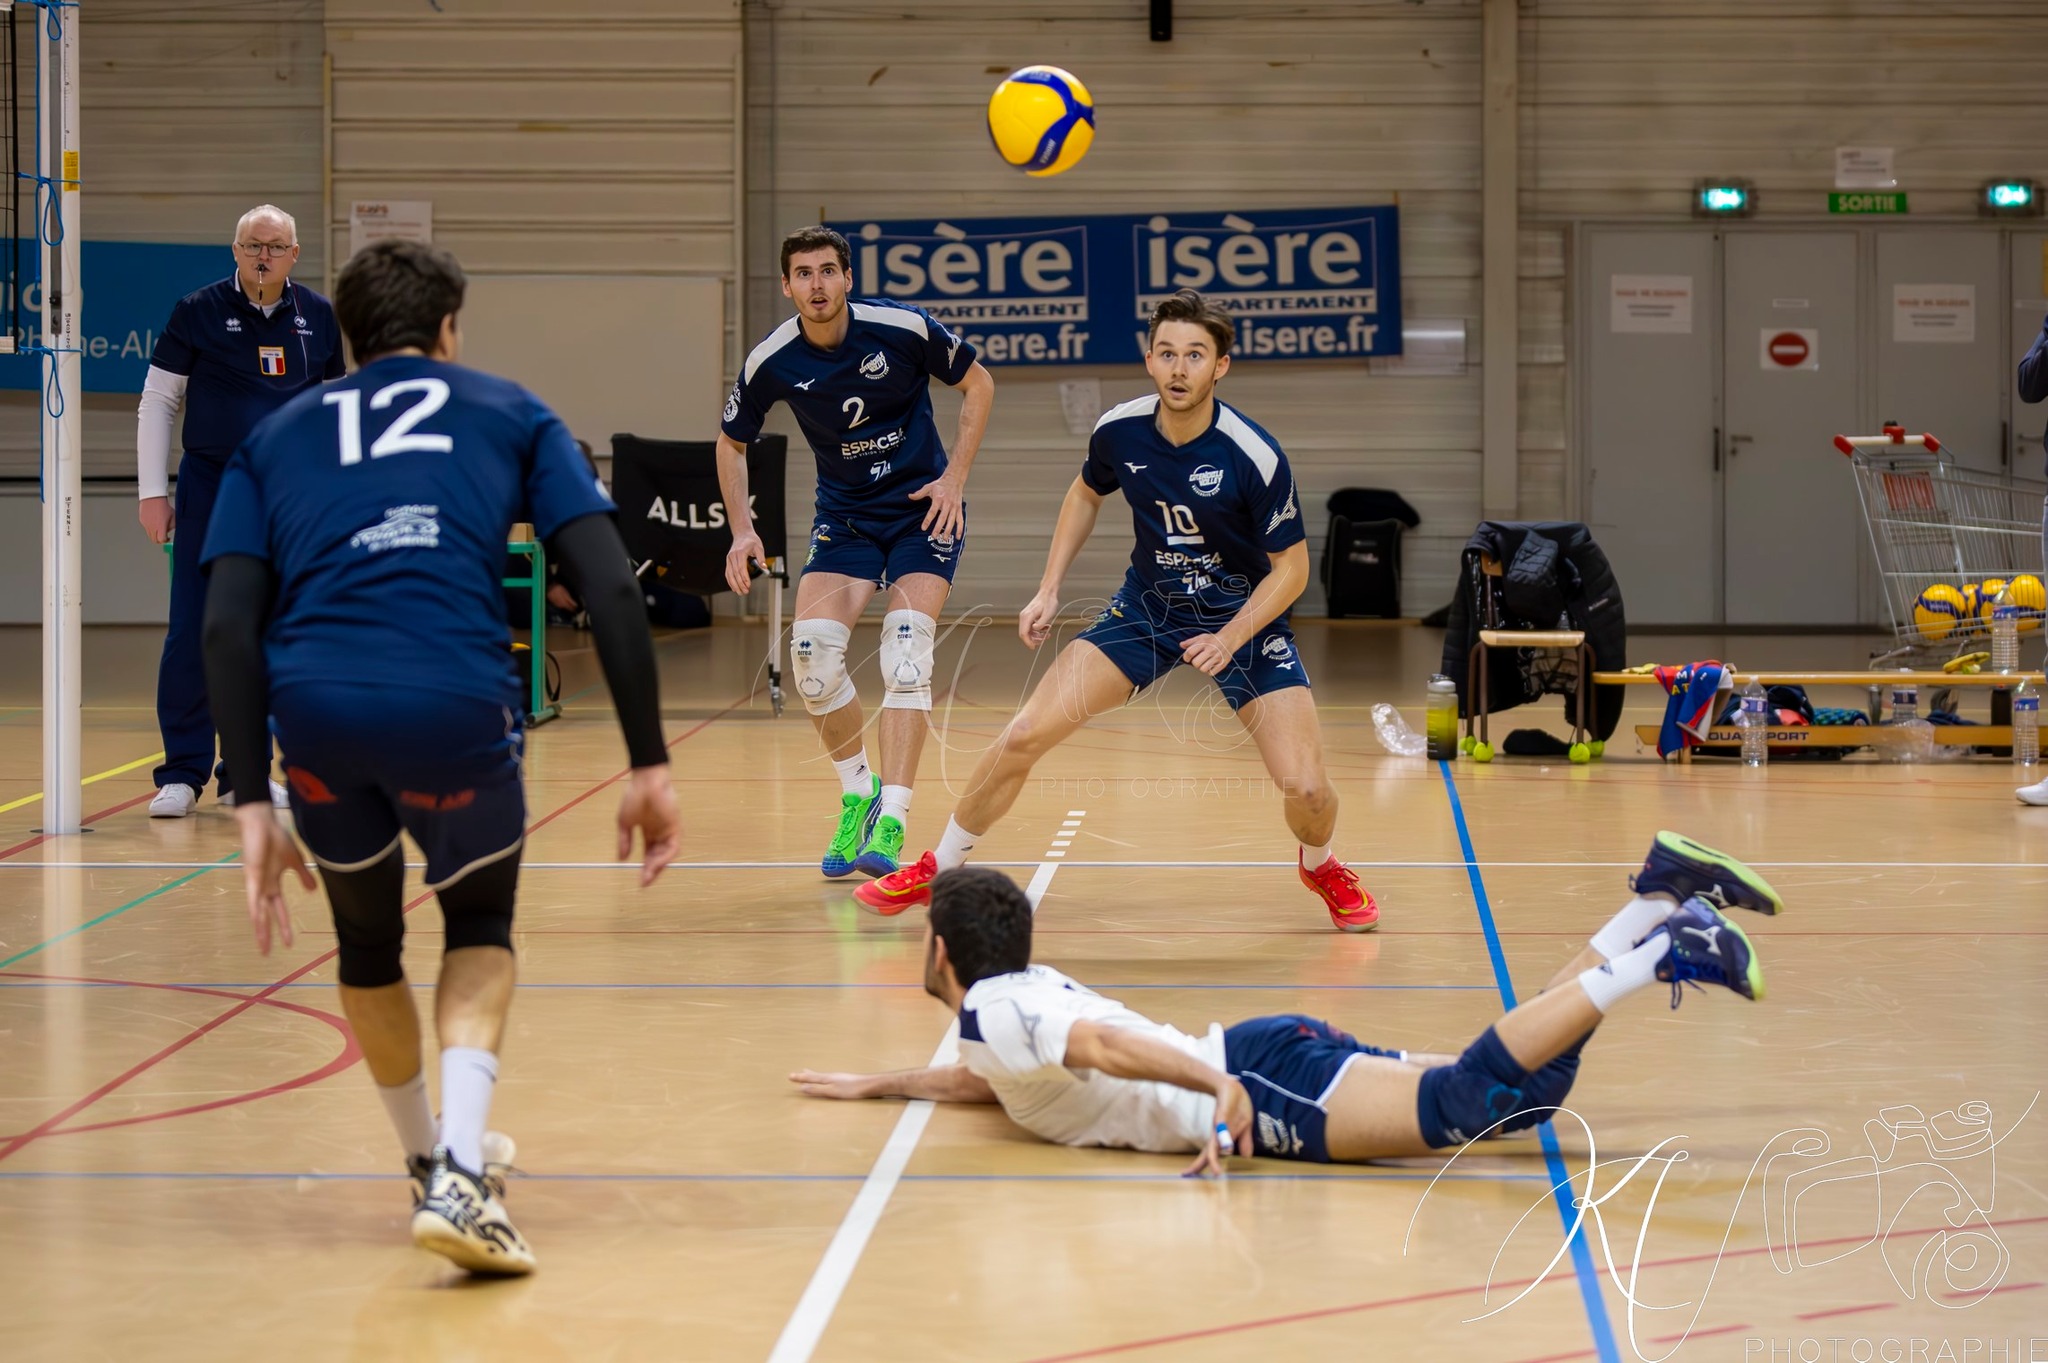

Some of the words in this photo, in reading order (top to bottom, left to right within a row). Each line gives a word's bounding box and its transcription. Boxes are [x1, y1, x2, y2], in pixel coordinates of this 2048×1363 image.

[1838, 194, 1897, 211] SORTIE
[860, 223, 1073, 296] isère
[1148, 214, 1361, 288] isère
[322, 377, 453, 466] 12
[842, 396, 870, 429] 2
[1155, 500, 1200, 535] 10
